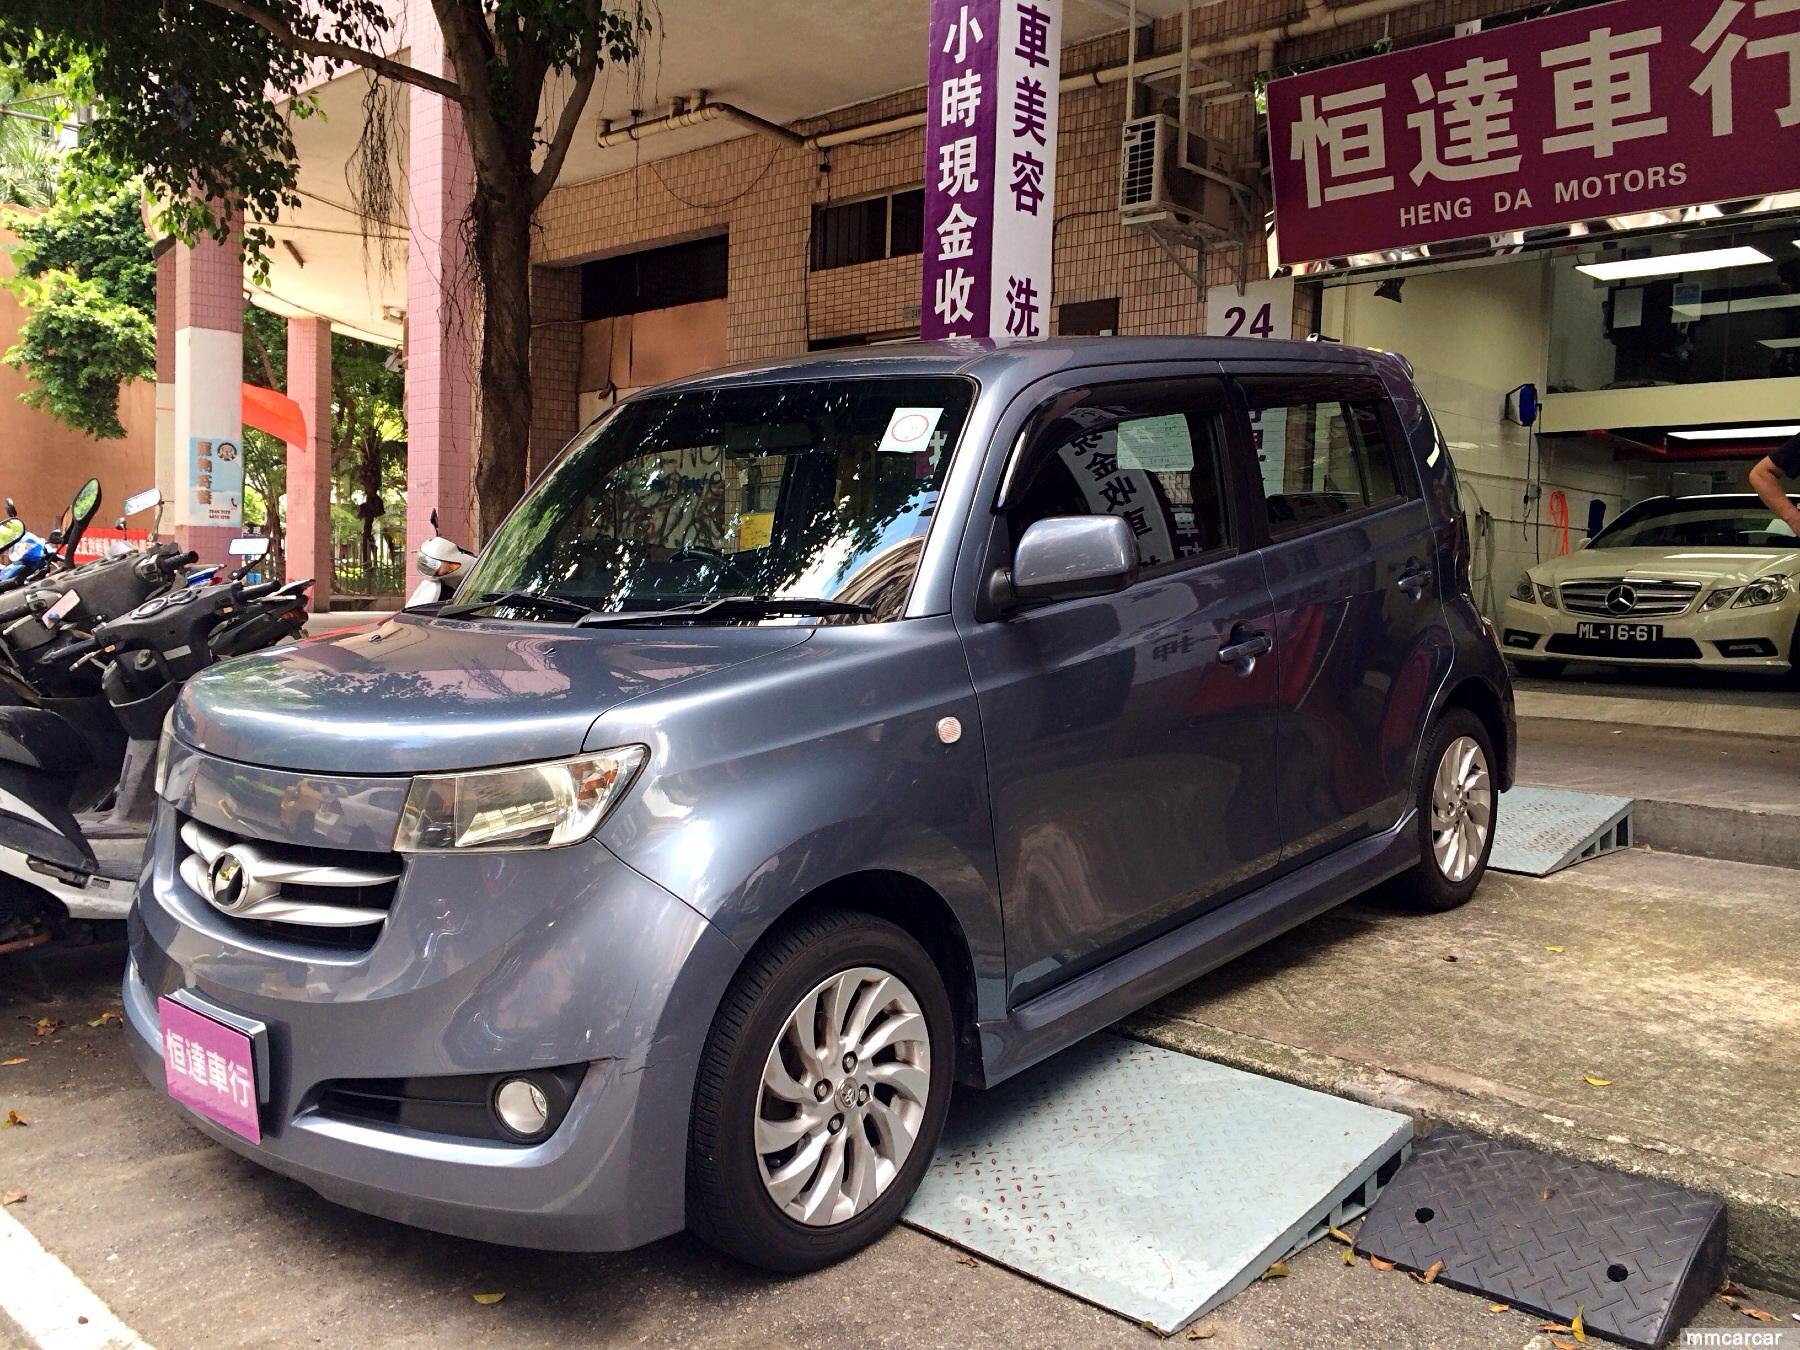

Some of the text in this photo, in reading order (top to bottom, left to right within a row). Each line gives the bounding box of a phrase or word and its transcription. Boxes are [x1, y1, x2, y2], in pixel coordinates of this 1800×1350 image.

[1290, 0, 1800, 208] 恒達車行
[934, 5, 984, 339] 小時現金收
[1005, 3, 1051, 337] 車美容 洗
[1399, 162, 1688, 228] HENG DA MOTORS
[1224, 303, 1274, 338] 24
[1578, 623, 1657, 642] ML-16-61
[166, 1027, 250, 1108] 恒達車行
